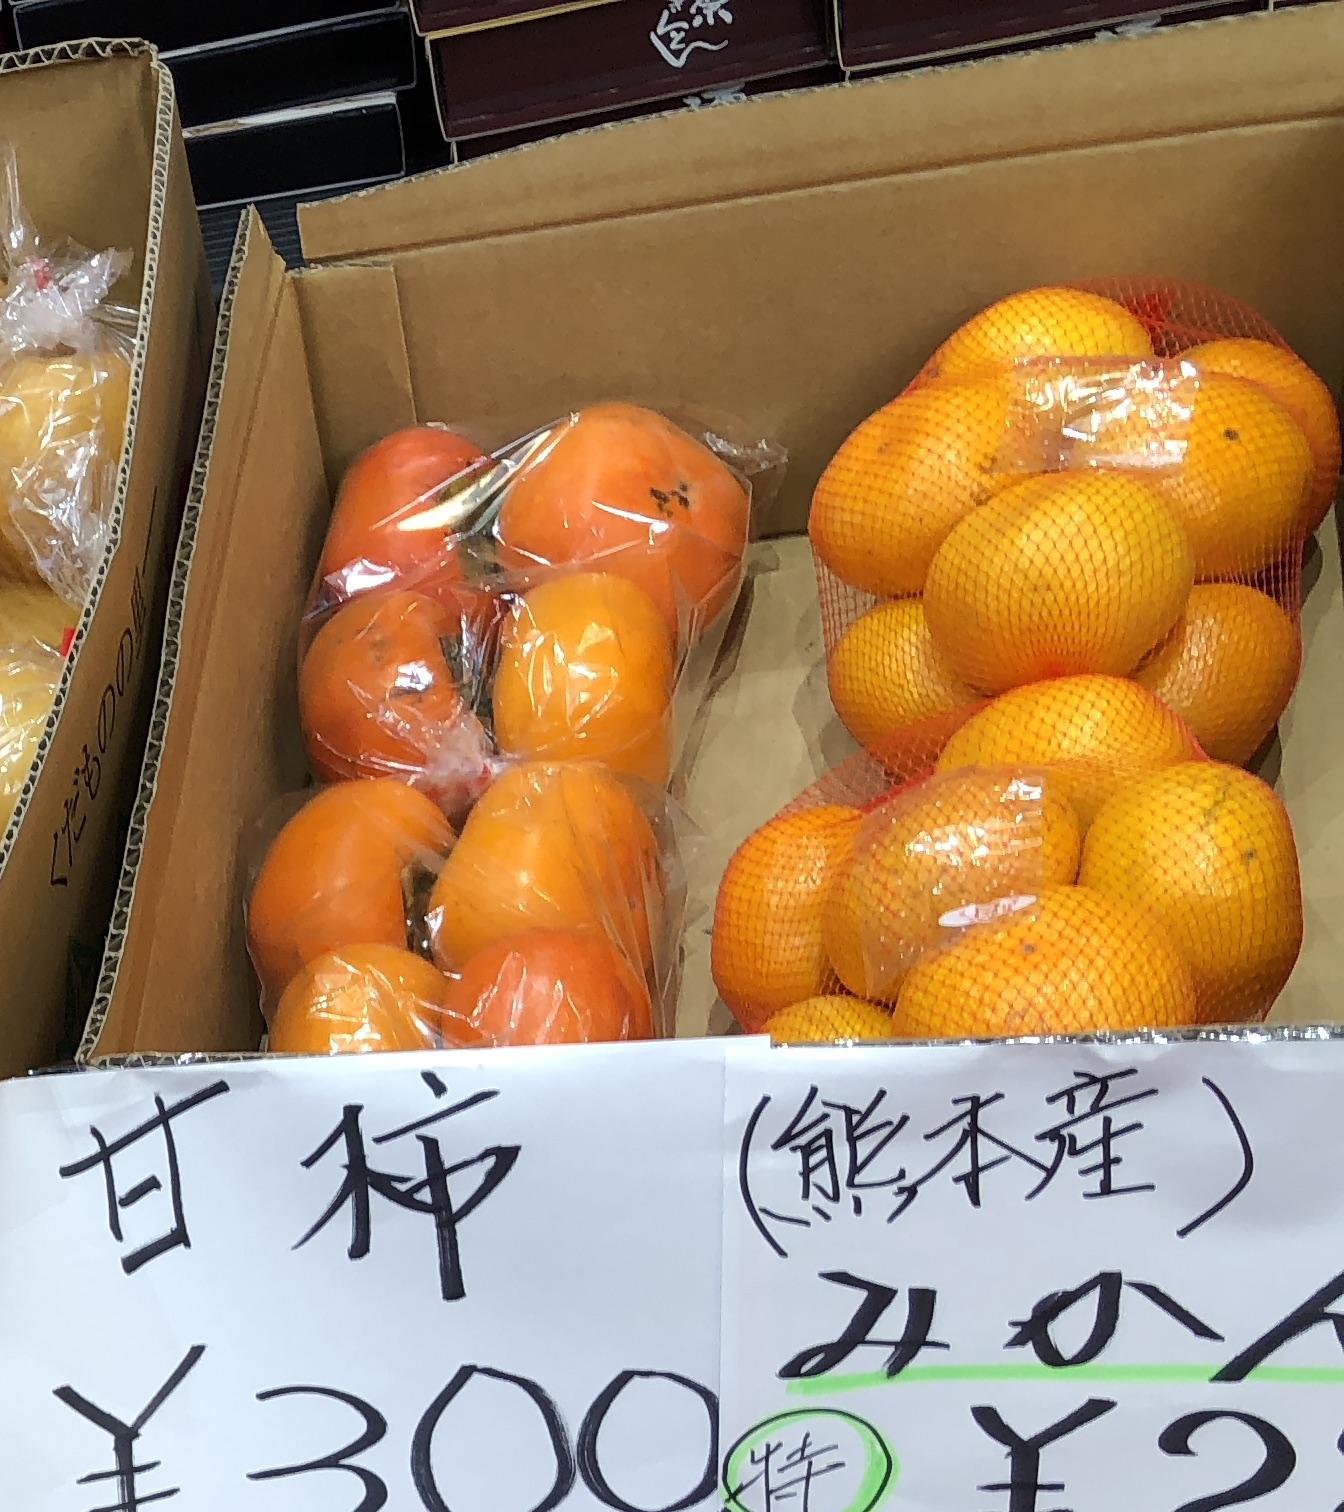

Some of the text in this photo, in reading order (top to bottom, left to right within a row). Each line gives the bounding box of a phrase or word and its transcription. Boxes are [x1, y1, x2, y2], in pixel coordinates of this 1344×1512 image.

[58, 1070, 523, 1302] 甘柿
[739, 1067, 1255, 1258] (熊本産)
